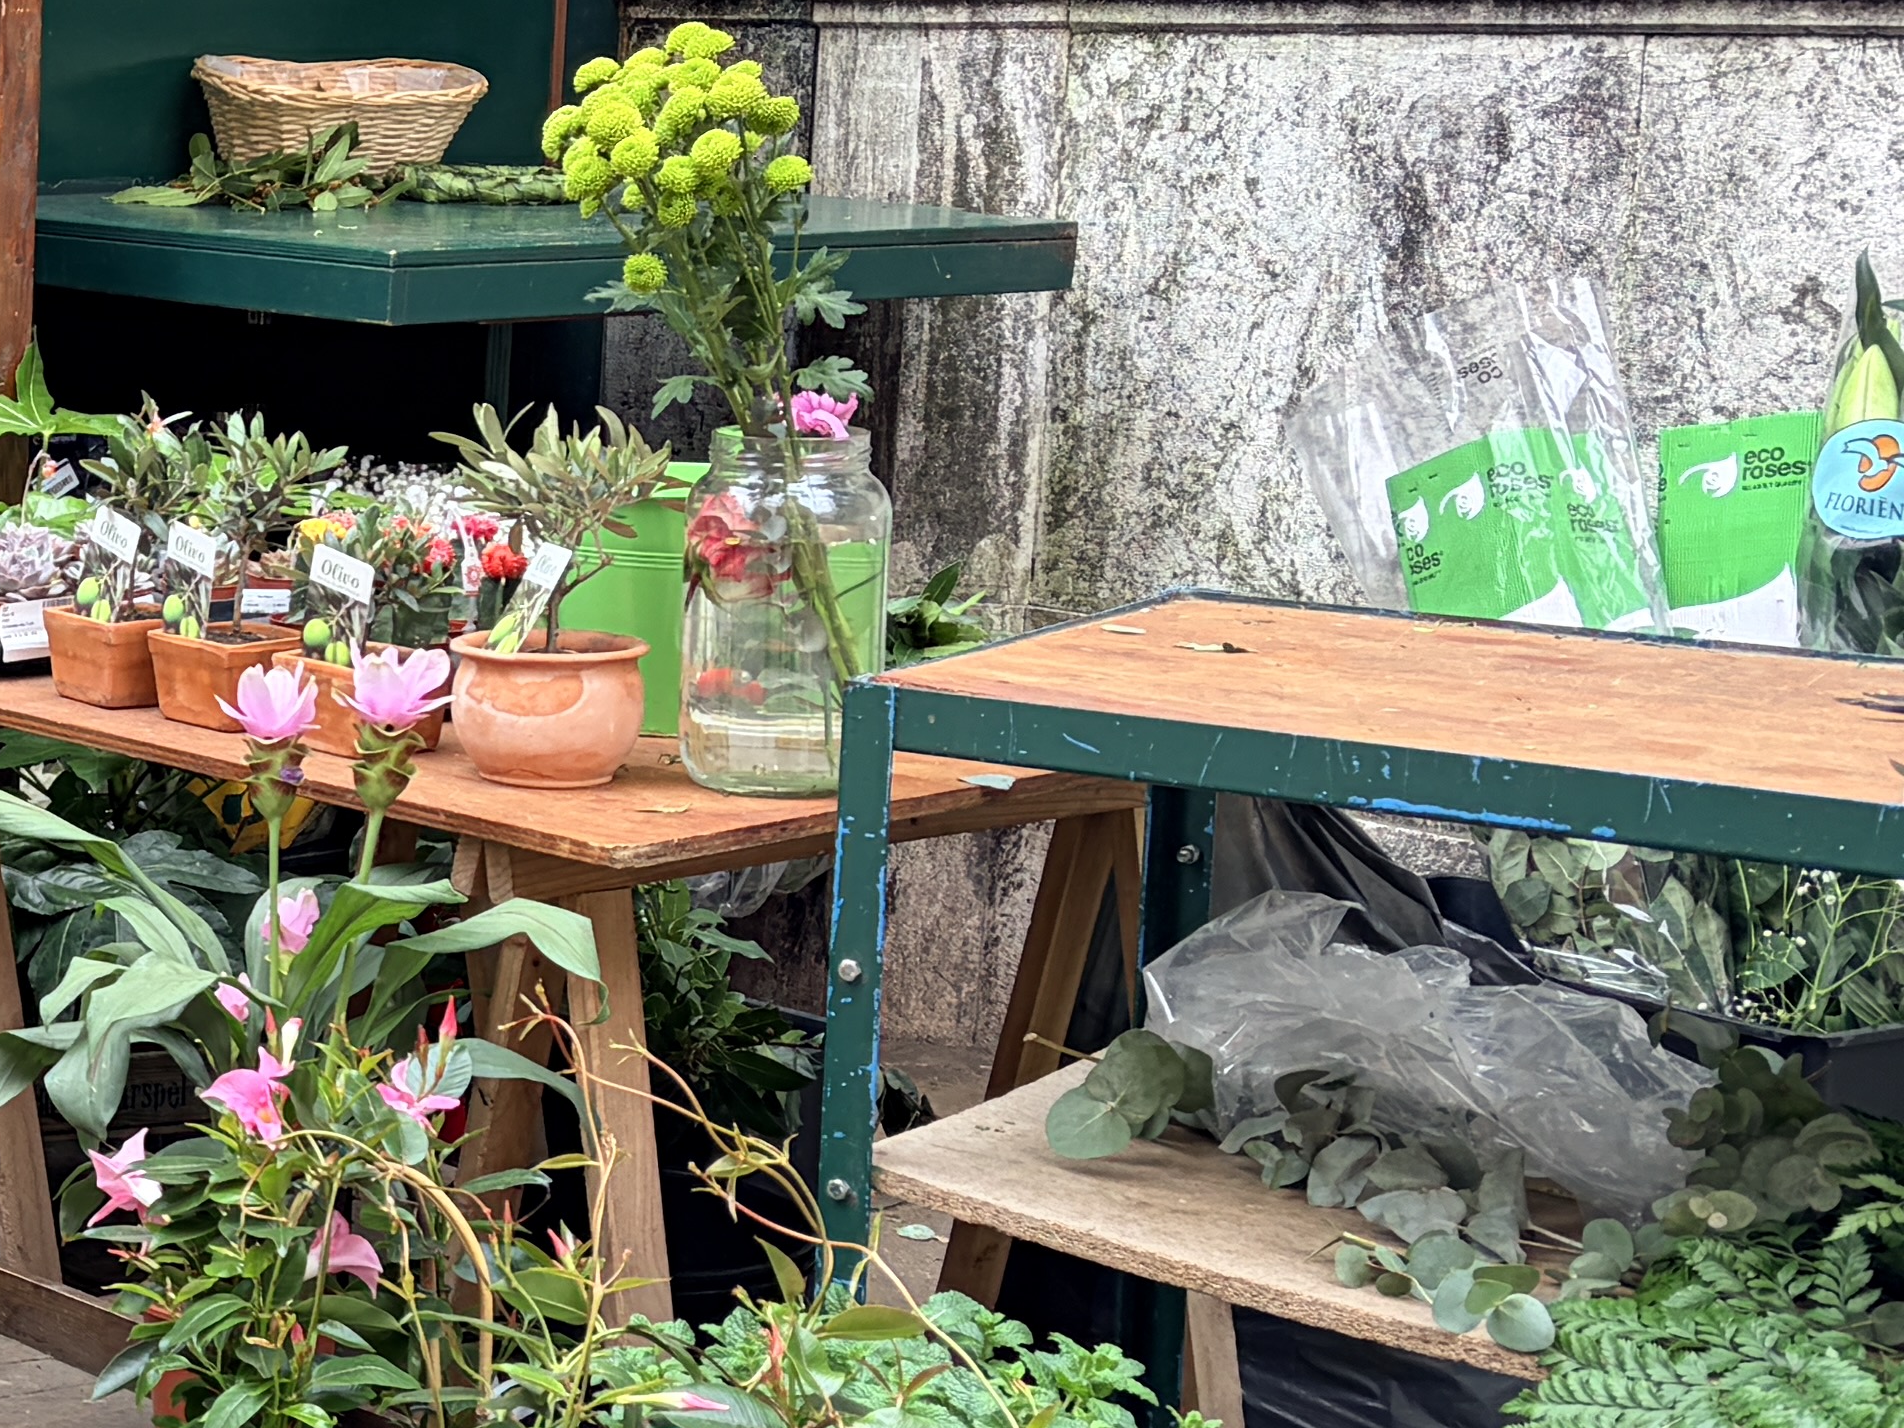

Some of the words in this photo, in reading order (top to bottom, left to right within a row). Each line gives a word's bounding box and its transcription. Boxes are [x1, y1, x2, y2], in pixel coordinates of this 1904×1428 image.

[1477, 365, 1504, 384] co
[1744, 446, 1785, 465] eco
[100, 520, 129, 550] Olivo
[175, 535, 206, 564] Olivo
[1406, 542, 1425, 562] co
[320, 558, 361, 590] Olivo
